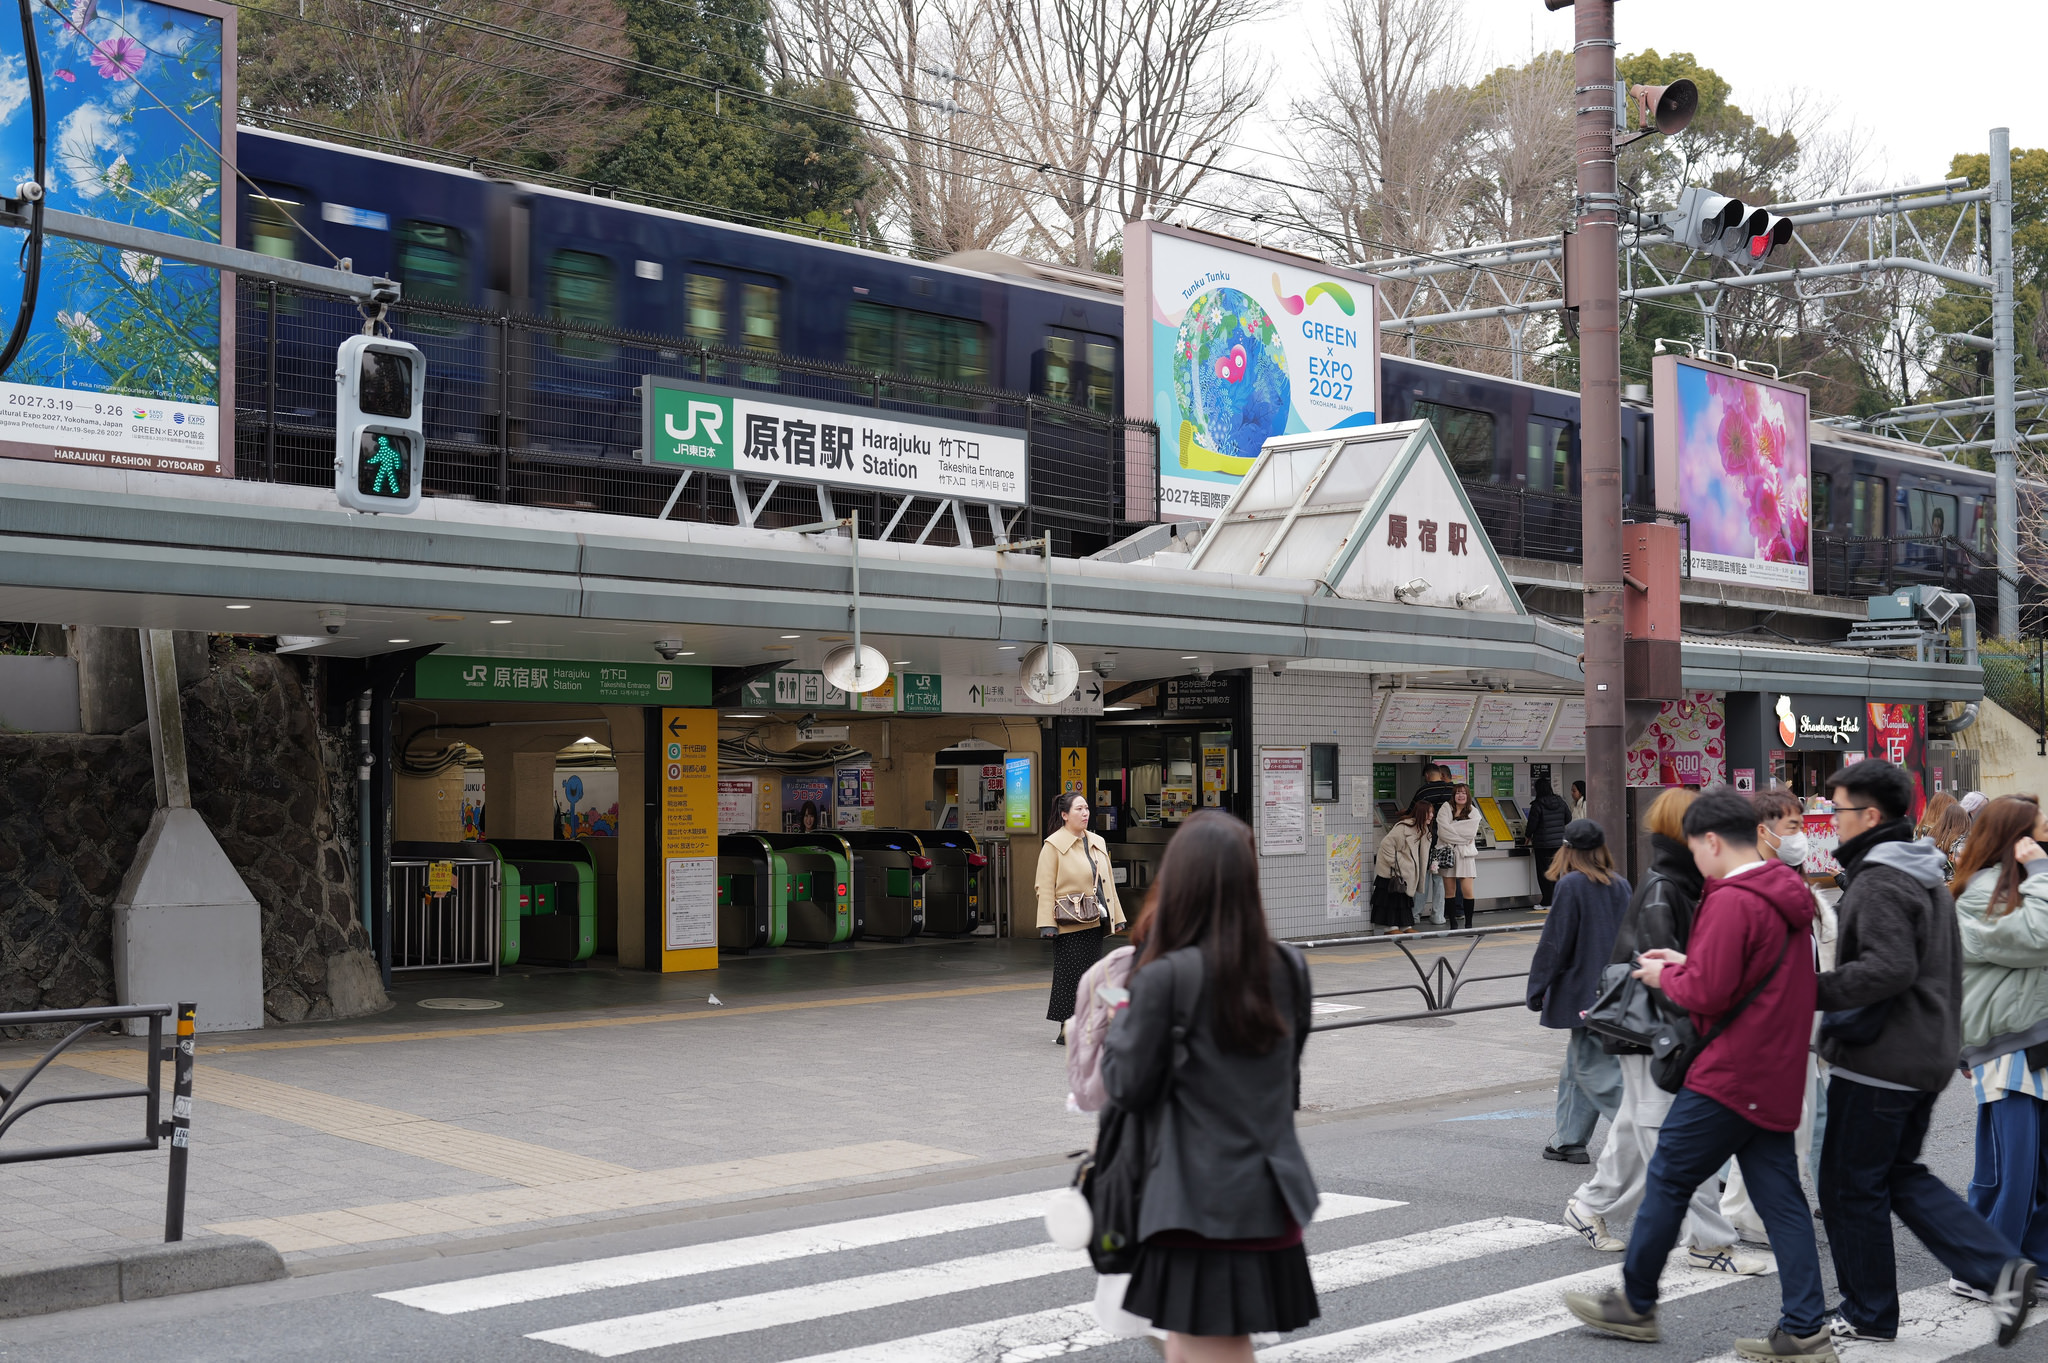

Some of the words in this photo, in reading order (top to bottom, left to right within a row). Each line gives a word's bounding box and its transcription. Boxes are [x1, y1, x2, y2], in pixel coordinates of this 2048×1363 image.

[1181, 277, 1205, 300] Tunku
[1205, 270, 1230, 282] Tunku
[1302, 320, 1357, 348] GREEN
[1309, 356, 1353, 381] EXPO
[79, 381, 92, 389] mika
[1309, 378, 1353, 401] 2027
[94, 404, 123, 416] 9.26
[1309, 399, 1338, 410] YOKOHAMA
[1338, 403, 1353, 412] JAPAN
[21, 421, 54, 431] Prefecture
[23, 412, 41, 420] Expo
[64, 415, 101, 426] Yokohama,
[103, 420, 123, 429] Japan
[188, 416, 205, 424] EXPO
[665, 400, 724, 445] JR
[743, 413, 854, 471] 原宿駅
[862, 427, 931, 457] Harajuku
[938, 437, 980, 460] 竹下口
[673, 443, 716, 459] JR東日本
[54, 449, 105, 463] HARAJUKU
[111, 454, 151, 467] FASHION
[157, 459, 205, 472] JOYBOARD
[215, 465, 221, 473] 5
[862, 454, 918, 479] Station
[938, 460, 977, 475] Takeshita
[979, 465, 1015, 480] Entrance
[938, 474, 966, 487] 竹下入口
[970, 479, 999, 491] 다케시타
[1001, 482, 1016, 492] 입구
[1387, 513, 1468, 557] 原宿駅
[1682, 556, 1748, 575] 227年国際園芸博覧会
[463, 665, 488, 681] JR
[493, 667, 548, 689] 原宿駅
[553, 668, 590, 680] Harajuku
[600, 668, 627, 680] 竹下口
[660, 676, 669, 685] JY
[916, 676, 931, 686] JR
[553, 680, 582, 690] Station
[985, 686, 1004, 696] 山手線
[906, 693, 940, 705] 竹下改札
[1800, 715, 1838, 744] Strawberry
[1835, 716, 1860, 732] Fetish
[682, 744, 707, 753] 千代田線
[683, 765, 707, 773] 副都心線
[1675, 755, 1699, 771] 600
